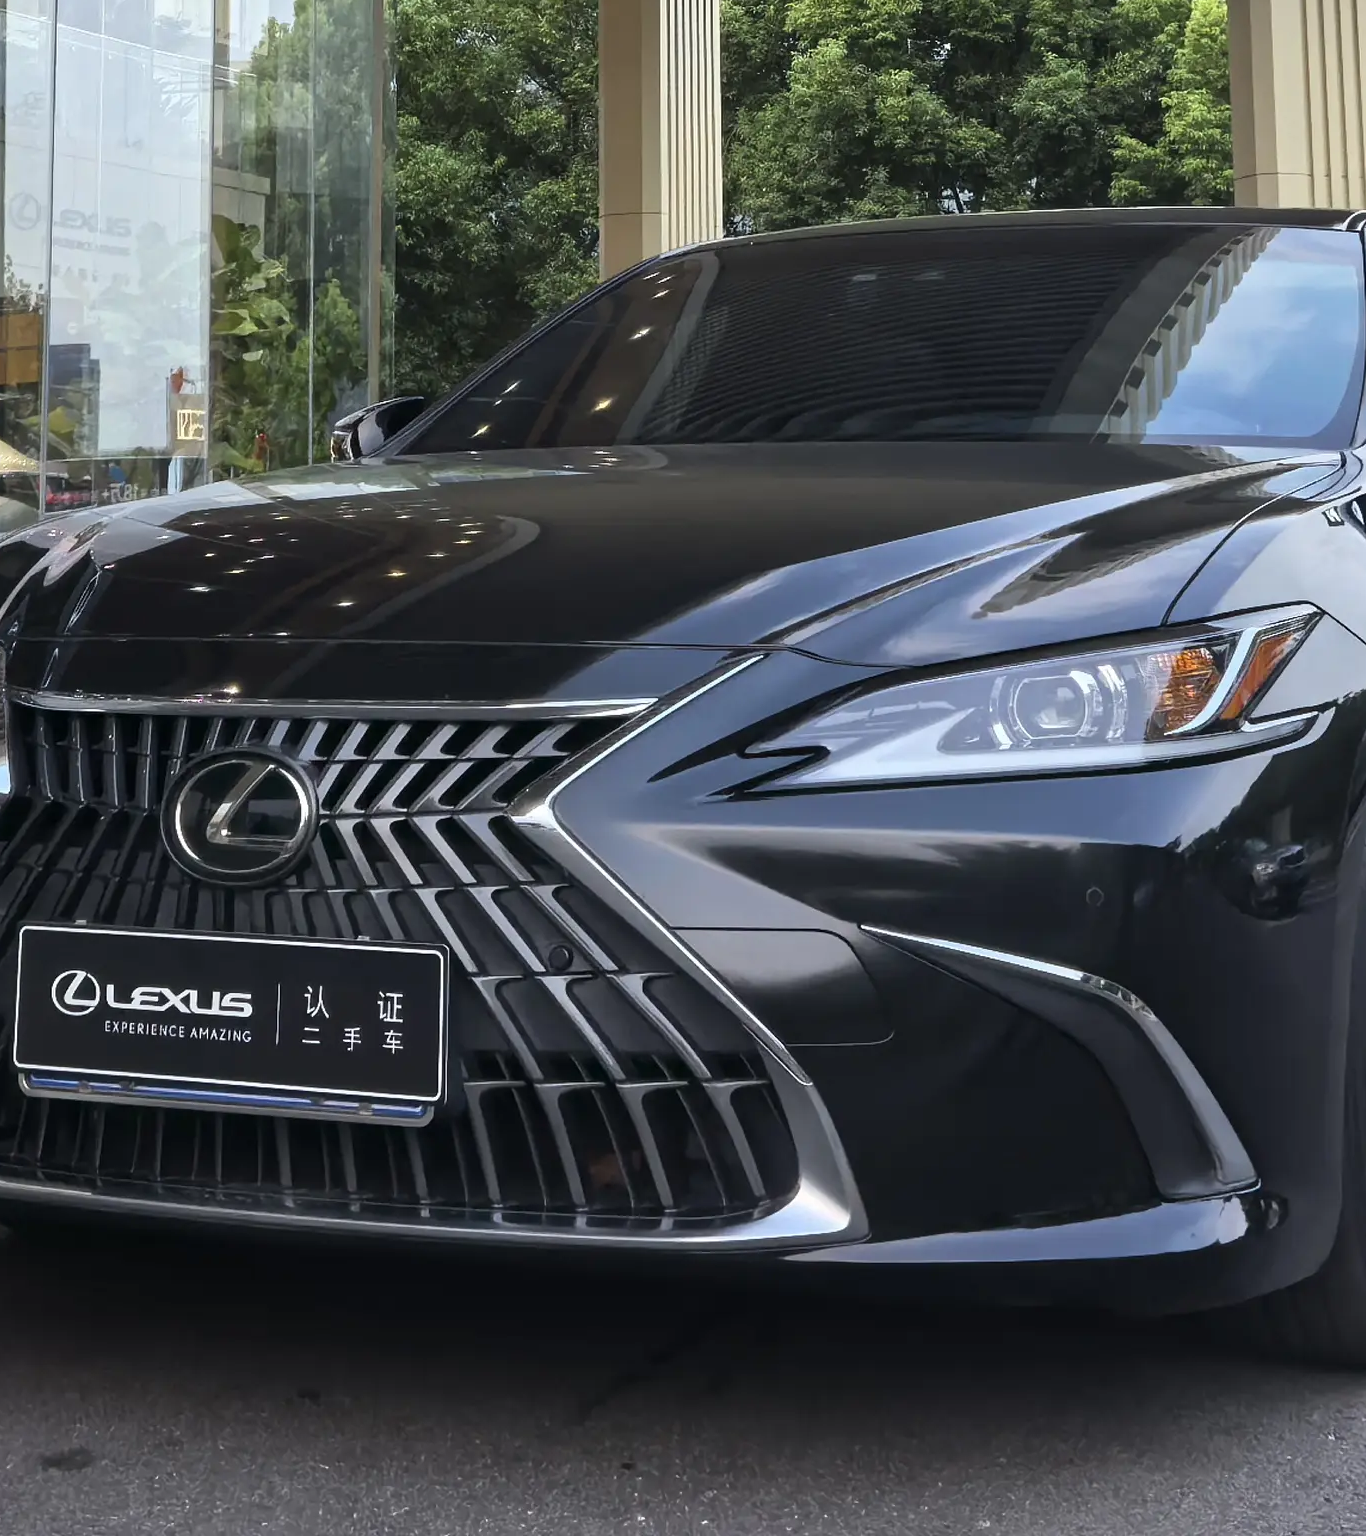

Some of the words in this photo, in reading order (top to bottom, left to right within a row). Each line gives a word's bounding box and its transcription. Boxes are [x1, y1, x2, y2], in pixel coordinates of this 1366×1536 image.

[106, 984, 253, 1018] LEXUS
[104, 1020, 185, 1039] EXPERIENCE
[190, 1026, 252, 1044] AMAZING
